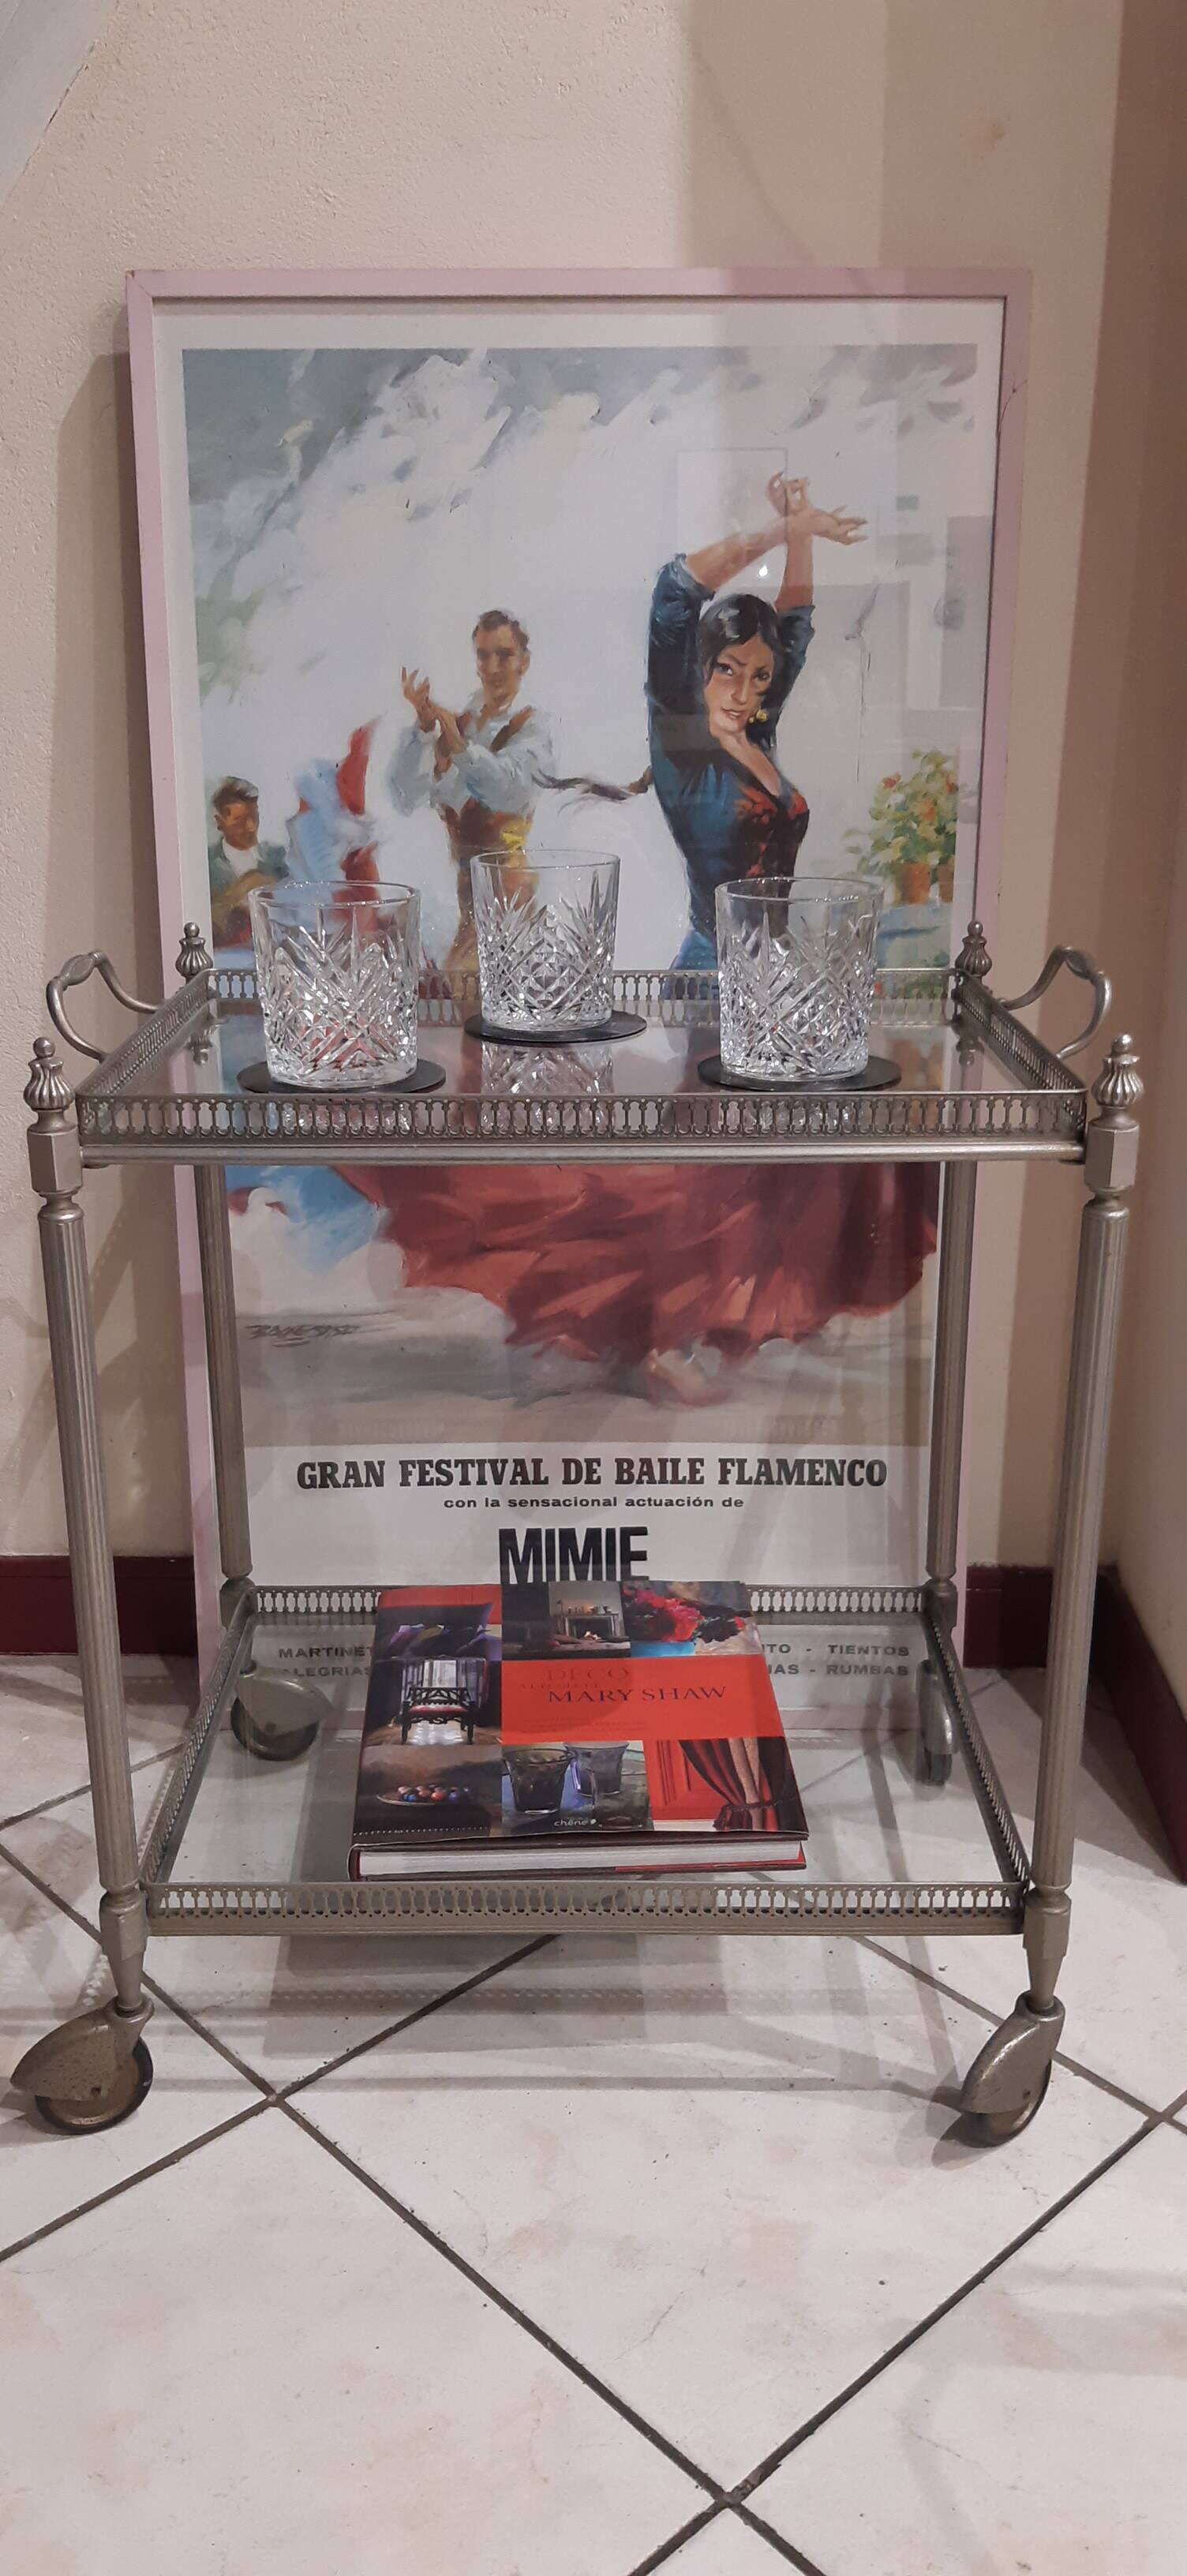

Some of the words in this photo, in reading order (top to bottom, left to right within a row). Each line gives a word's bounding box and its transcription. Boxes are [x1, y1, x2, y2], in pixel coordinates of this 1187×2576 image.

[297, 1460, 385, 1489] GRAN
[399, 1458, 549, 1486] FESTIVAL
[562, 1458, 601, 1485] DE
[614, 1458, 705, 1485] BAILE
[717, 1458, 887, 1486] FLAMENCO
[444, 1500, 477, 1508] con
[485, 1497, 500, 1507] la
[507, 1496, 617, 1507] sensacional
[625, 1496, 713, 1507] actuación
[721, 1497, 744, 1507] de
[499, 1526, 650, 1583] MIMIE
[827, 1644, 909, 1657] TIENTOS
[283, 1666, 372, 1677] LEGRIAS
[827, 1664, 908, 1676] RUMBAS
[549, 1689, 634, 1702] MARY
[642, 1686, 726, 1701] SHAW
